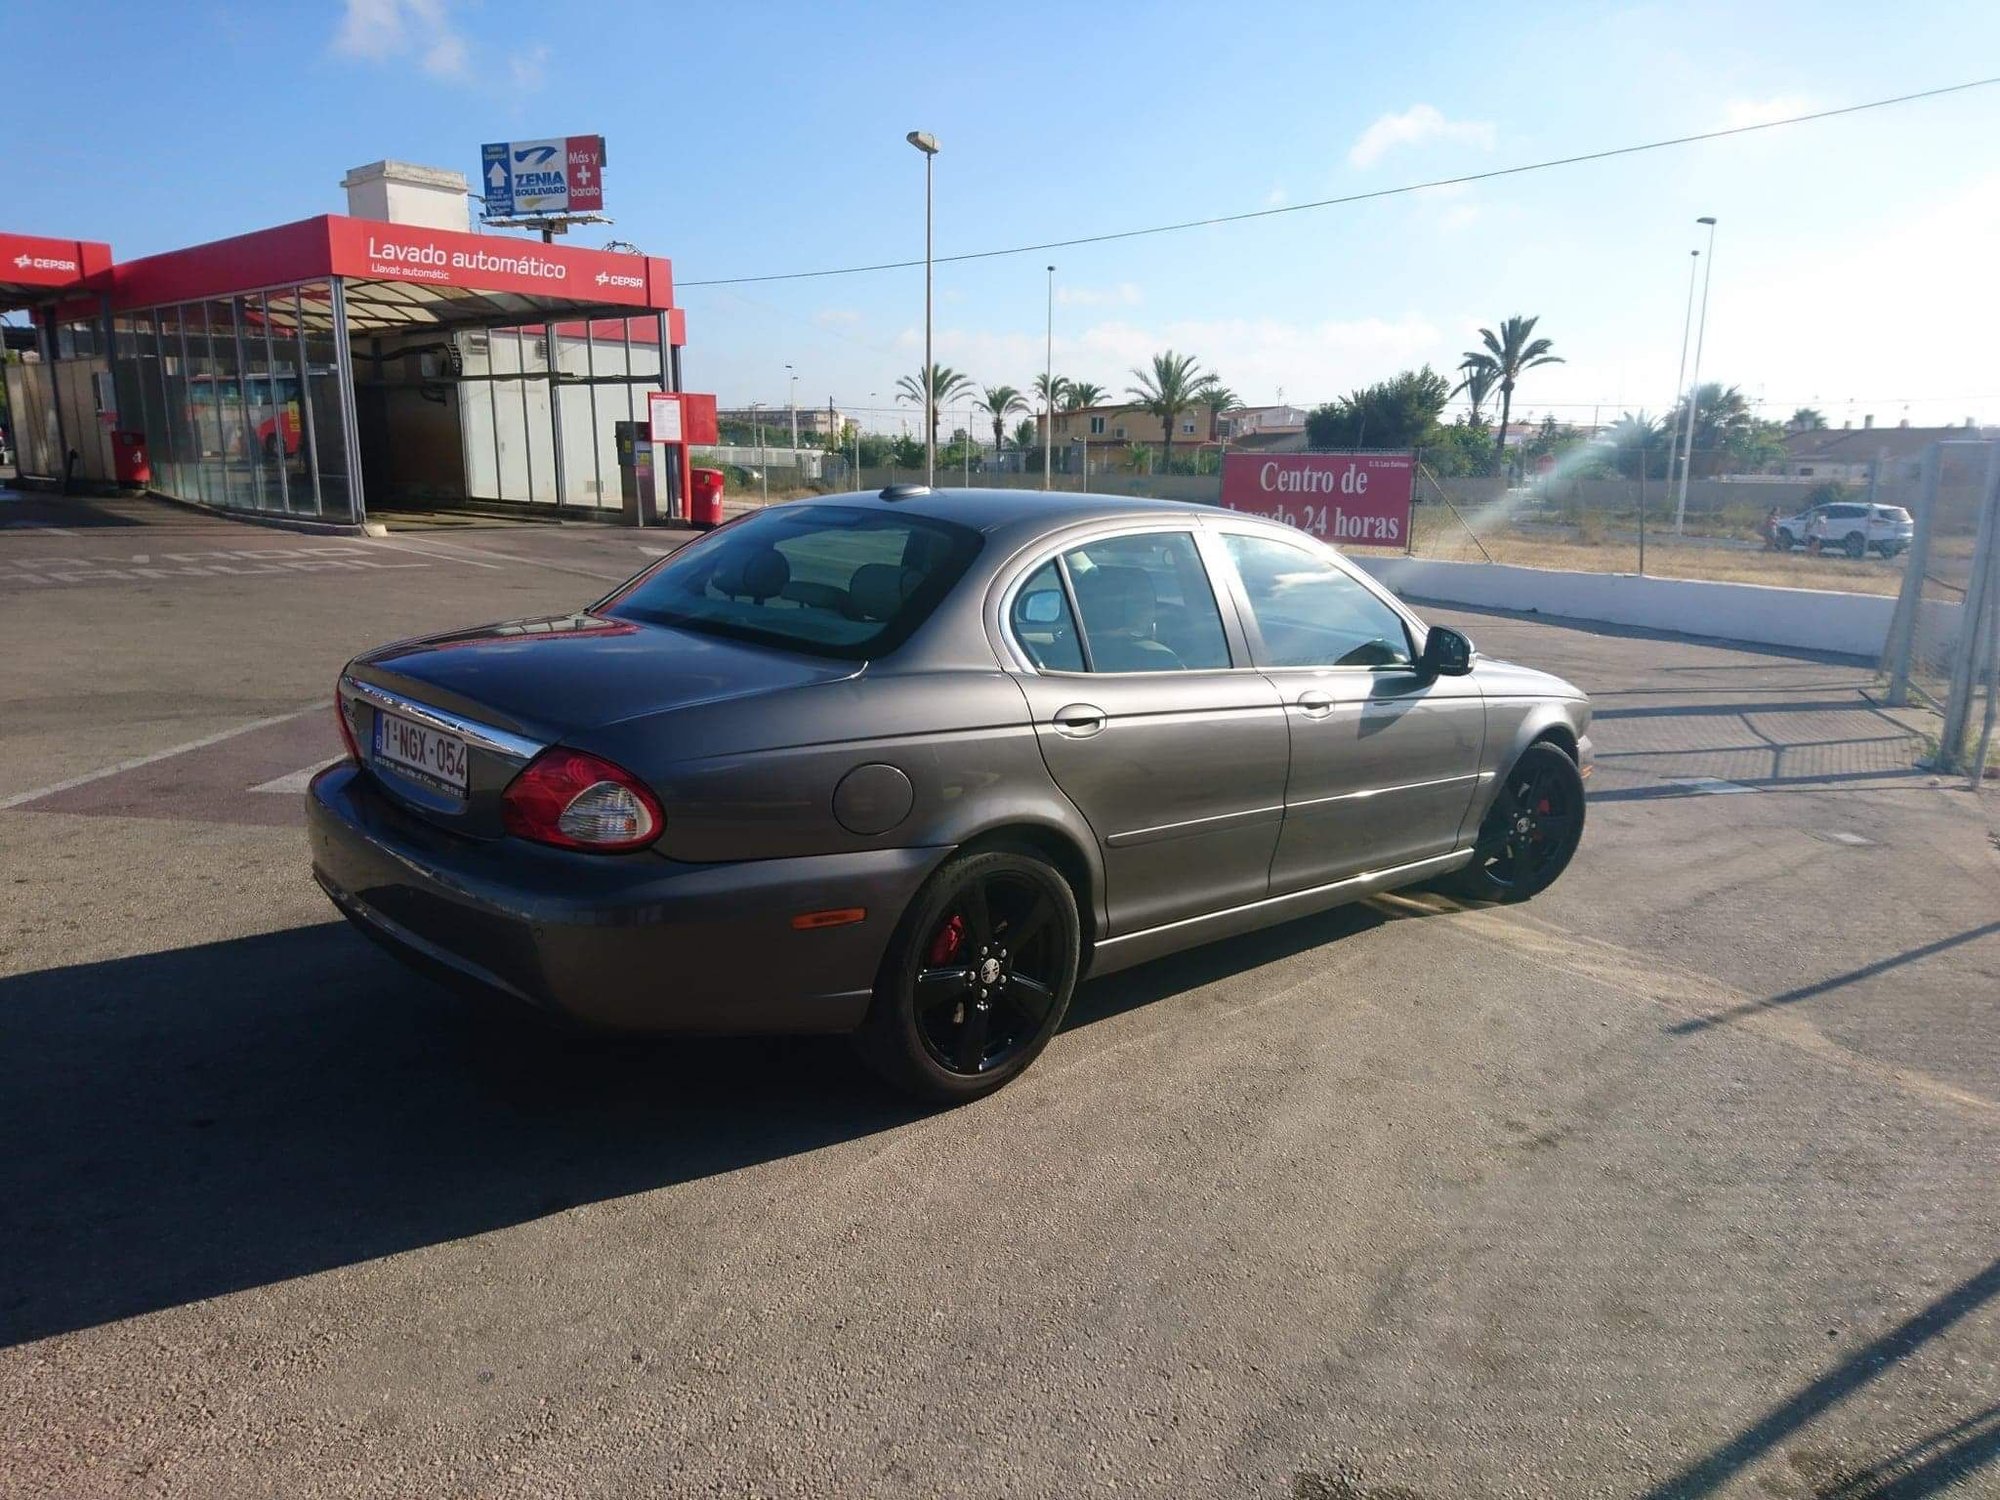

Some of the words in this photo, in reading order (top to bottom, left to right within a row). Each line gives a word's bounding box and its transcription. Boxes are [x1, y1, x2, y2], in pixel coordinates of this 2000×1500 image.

[568, 150, 589, 164] Más
[591, 152, 598, 165] y
[514, 171, 565, 188] ZENIA
[515, 186, 567, 197] BOULEVARD
[570, 186, 600, 197] barato
[33, 258, 76, 271] CEPSA
[368, 237, 447, 266] Lavado
[452, 250, 567, 280] automático
[371, 263, 400, 274] Llavat
[402, 267, 449, 280] automátic
[610, 275, 643, 288] CEPSA
[1260, 462, 1334, 494] Centro
[1341, 464, 1368, 494] de
[1303, 505, 1327, 537] 24
[1334, 507, 1400, 540] horas
[0, 547, 375, 572] AVADO
